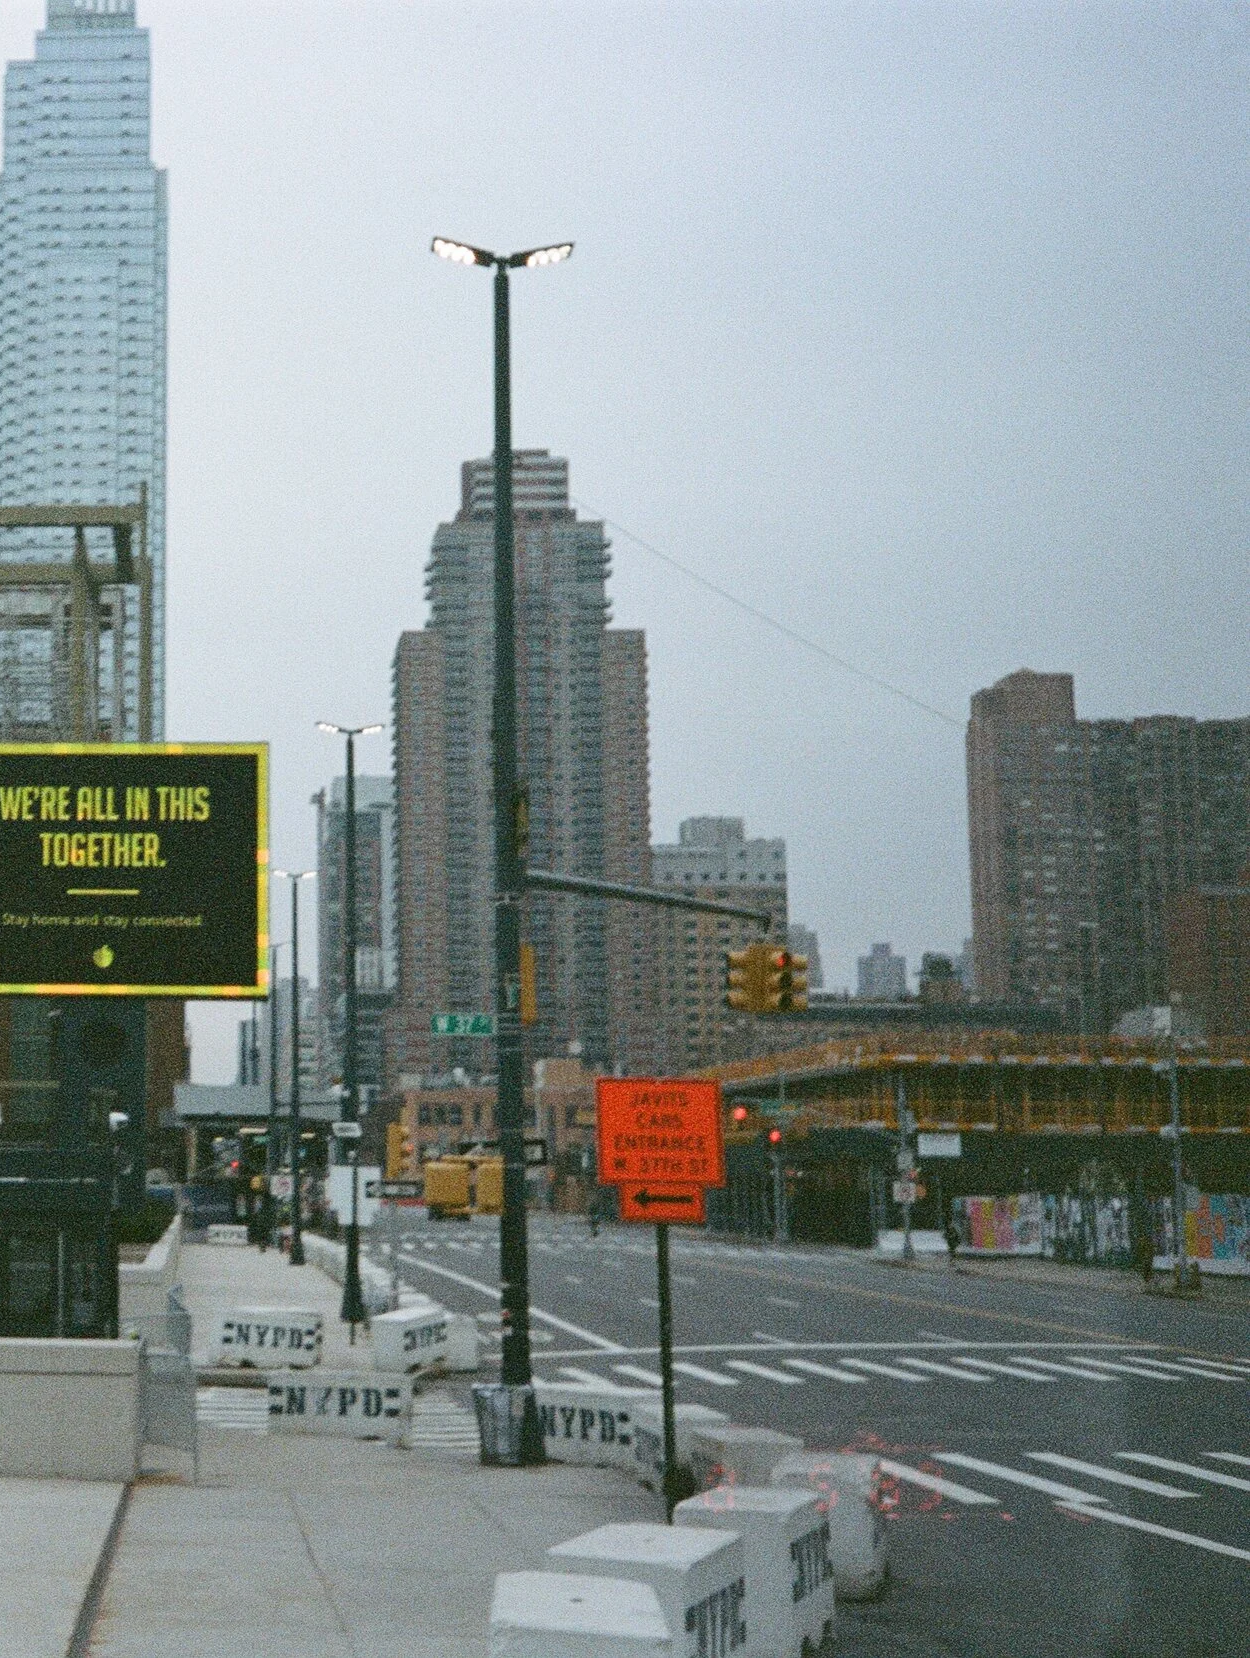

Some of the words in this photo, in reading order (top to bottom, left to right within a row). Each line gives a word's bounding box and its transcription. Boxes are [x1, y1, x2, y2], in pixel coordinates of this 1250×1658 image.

[0, 786, 71, 821] WE'RE
[76, 786, 120, 820] ALL
[125, 786, 150, 820] IN
[156, 786, 211, 821] THIS
[40, 833, 167, 867] TOGETHER.
[2, 912, 30, 928] Stay
[32, 913, 71, 926] home
[73, 913, 99, 926] and
[103, 914, 129, 929] stay
[613, 1133, 707, 1153] ENTRANCE
[286, 1386, 382, 1417] NYPD
